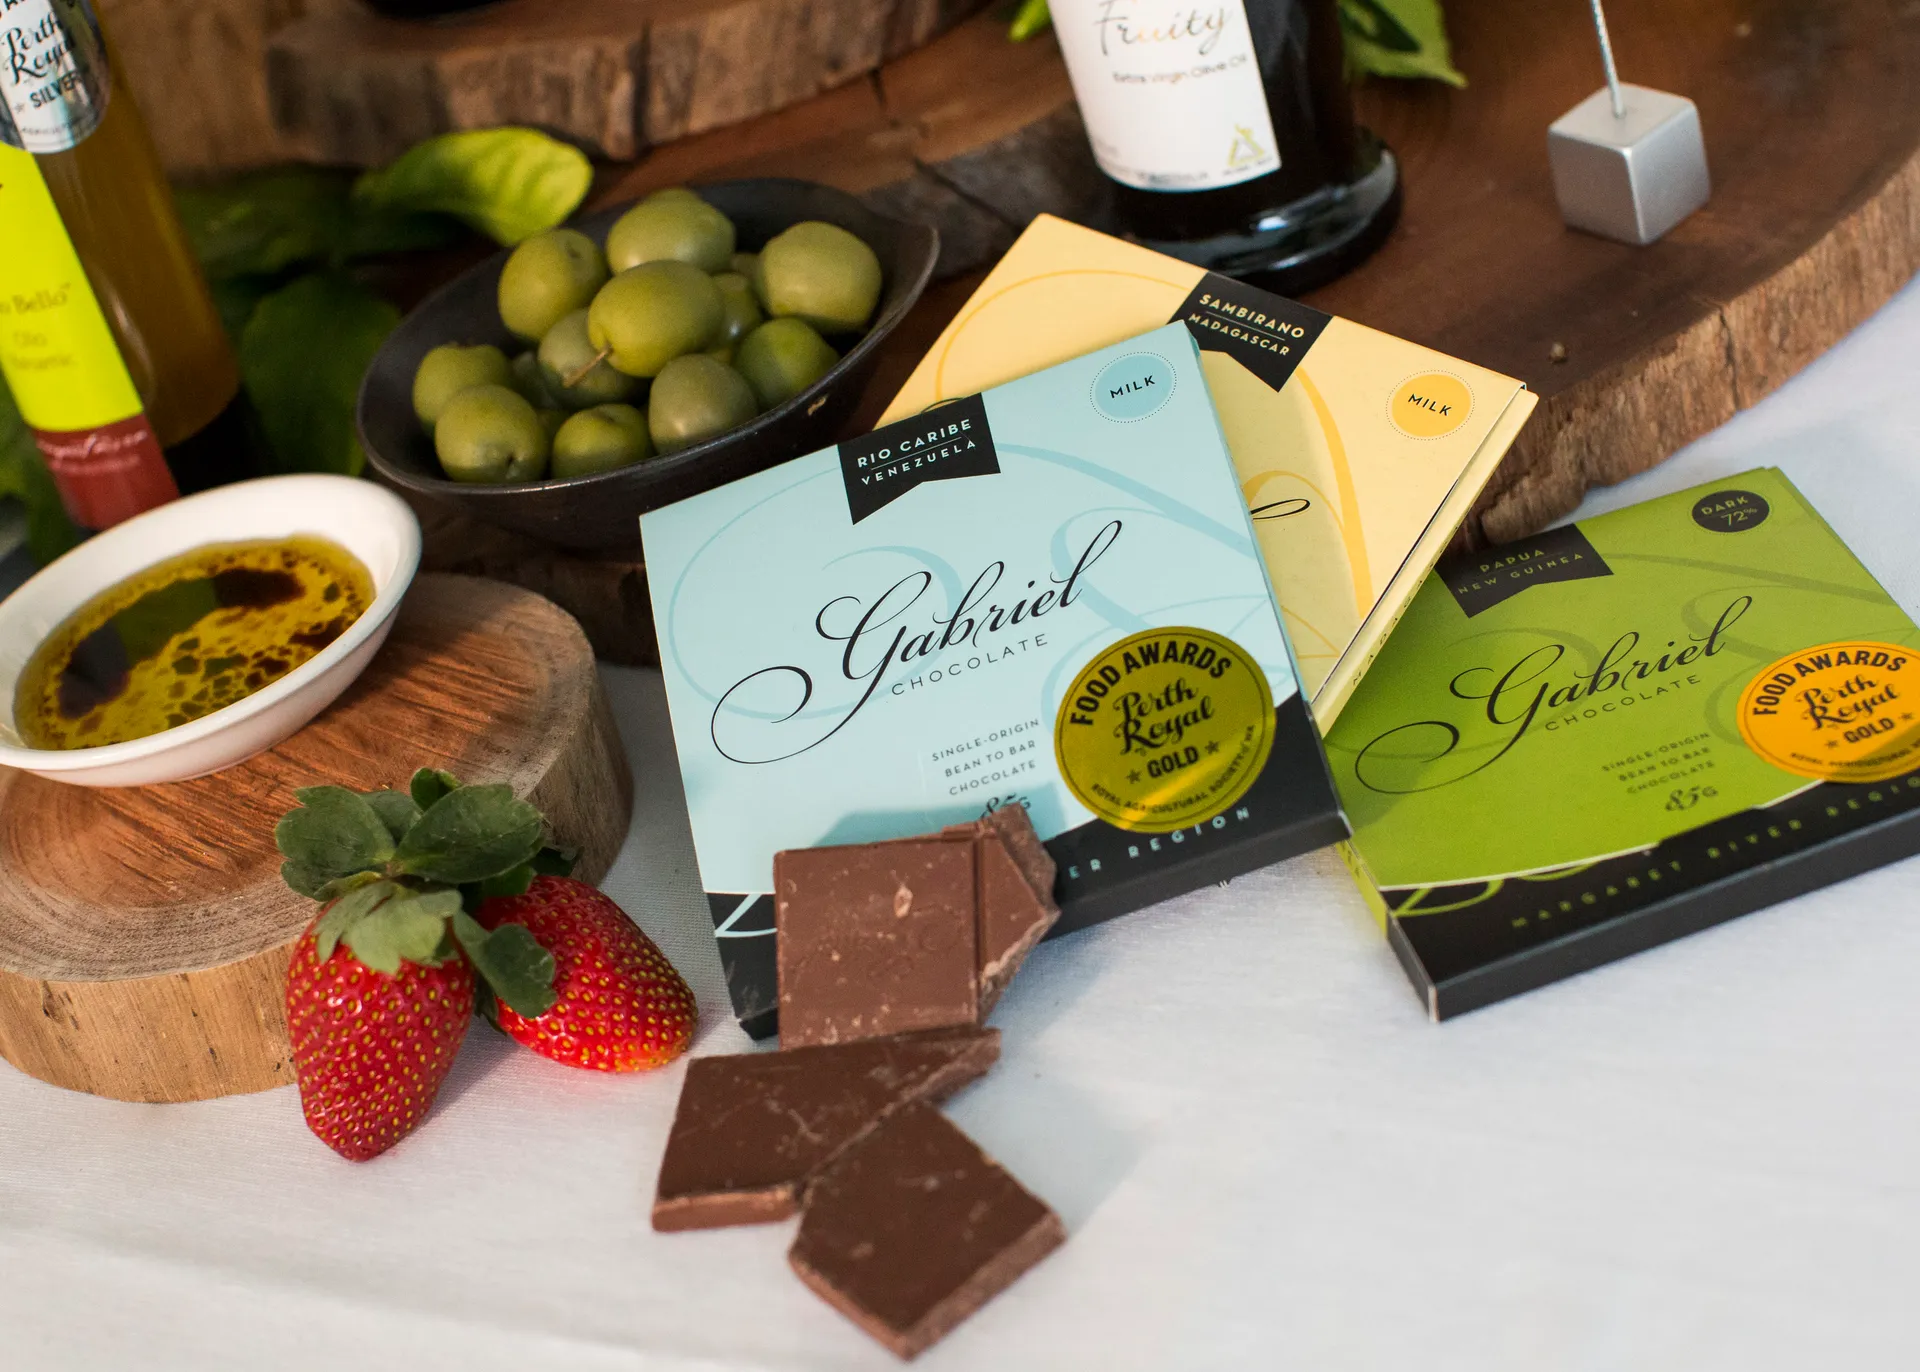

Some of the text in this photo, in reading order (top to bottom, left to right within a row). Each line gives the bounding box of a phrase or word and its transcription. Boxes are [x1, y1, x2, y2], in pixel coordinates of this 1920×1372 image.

[1094, 0, 1228, 56] Fruity
[1188, 312, 1291, 357] MADAGASCAR
[1199, 294, 1306, 340] SAMBIRANO
[1110, 375, 1155, 399] MILK
[1408, 393, 1452, 417] MILK
[857, 419, 972, 469] RIO CARIBE
[861, 440, 976, 486] VENEZUELA
[1701, 496, 1748, 515] DARK
[1458, 553, 1584, 595] NEW GUINEA
[1480, 549, 1545, 573] PAPUA
[711, 520, 1123, 765] Gabriel
[891, 633, 1049, 697] CHOCOLATE
[1069, 641, 1232, 726] FOOD AWARDS
[1113, 677, 1199, 722] Perth
[1354, 595, 1753, 795] Gabriel
[1544, 674, 1701, 731] CHOCOLATE
[1753, 650, 1907, 716] FOOD AWARDS
[1795, 675, 1880, 709] Perth
[1113, 696, 1215, 756] Royal
[1802, 683, 1900, 731] Royal
[932, 718, 1040, 762] SINGLE-ORIGIN
[1602, 732, 1710, 772] SINGLE-ORIGIN
[1844, 717, 1895, 744] GOLD
[945, 740, 1036, 778] BEAN TO BAR
[949, 760, 1036, 796] CHOCOLATE
[1147, 745, 1199, 779] GOLD
[1626, 760, 1715, 794] CHOCOLATE
[1665, 785, 1718, 812] 85G
[1128, 807, 1250, 859] REGION
